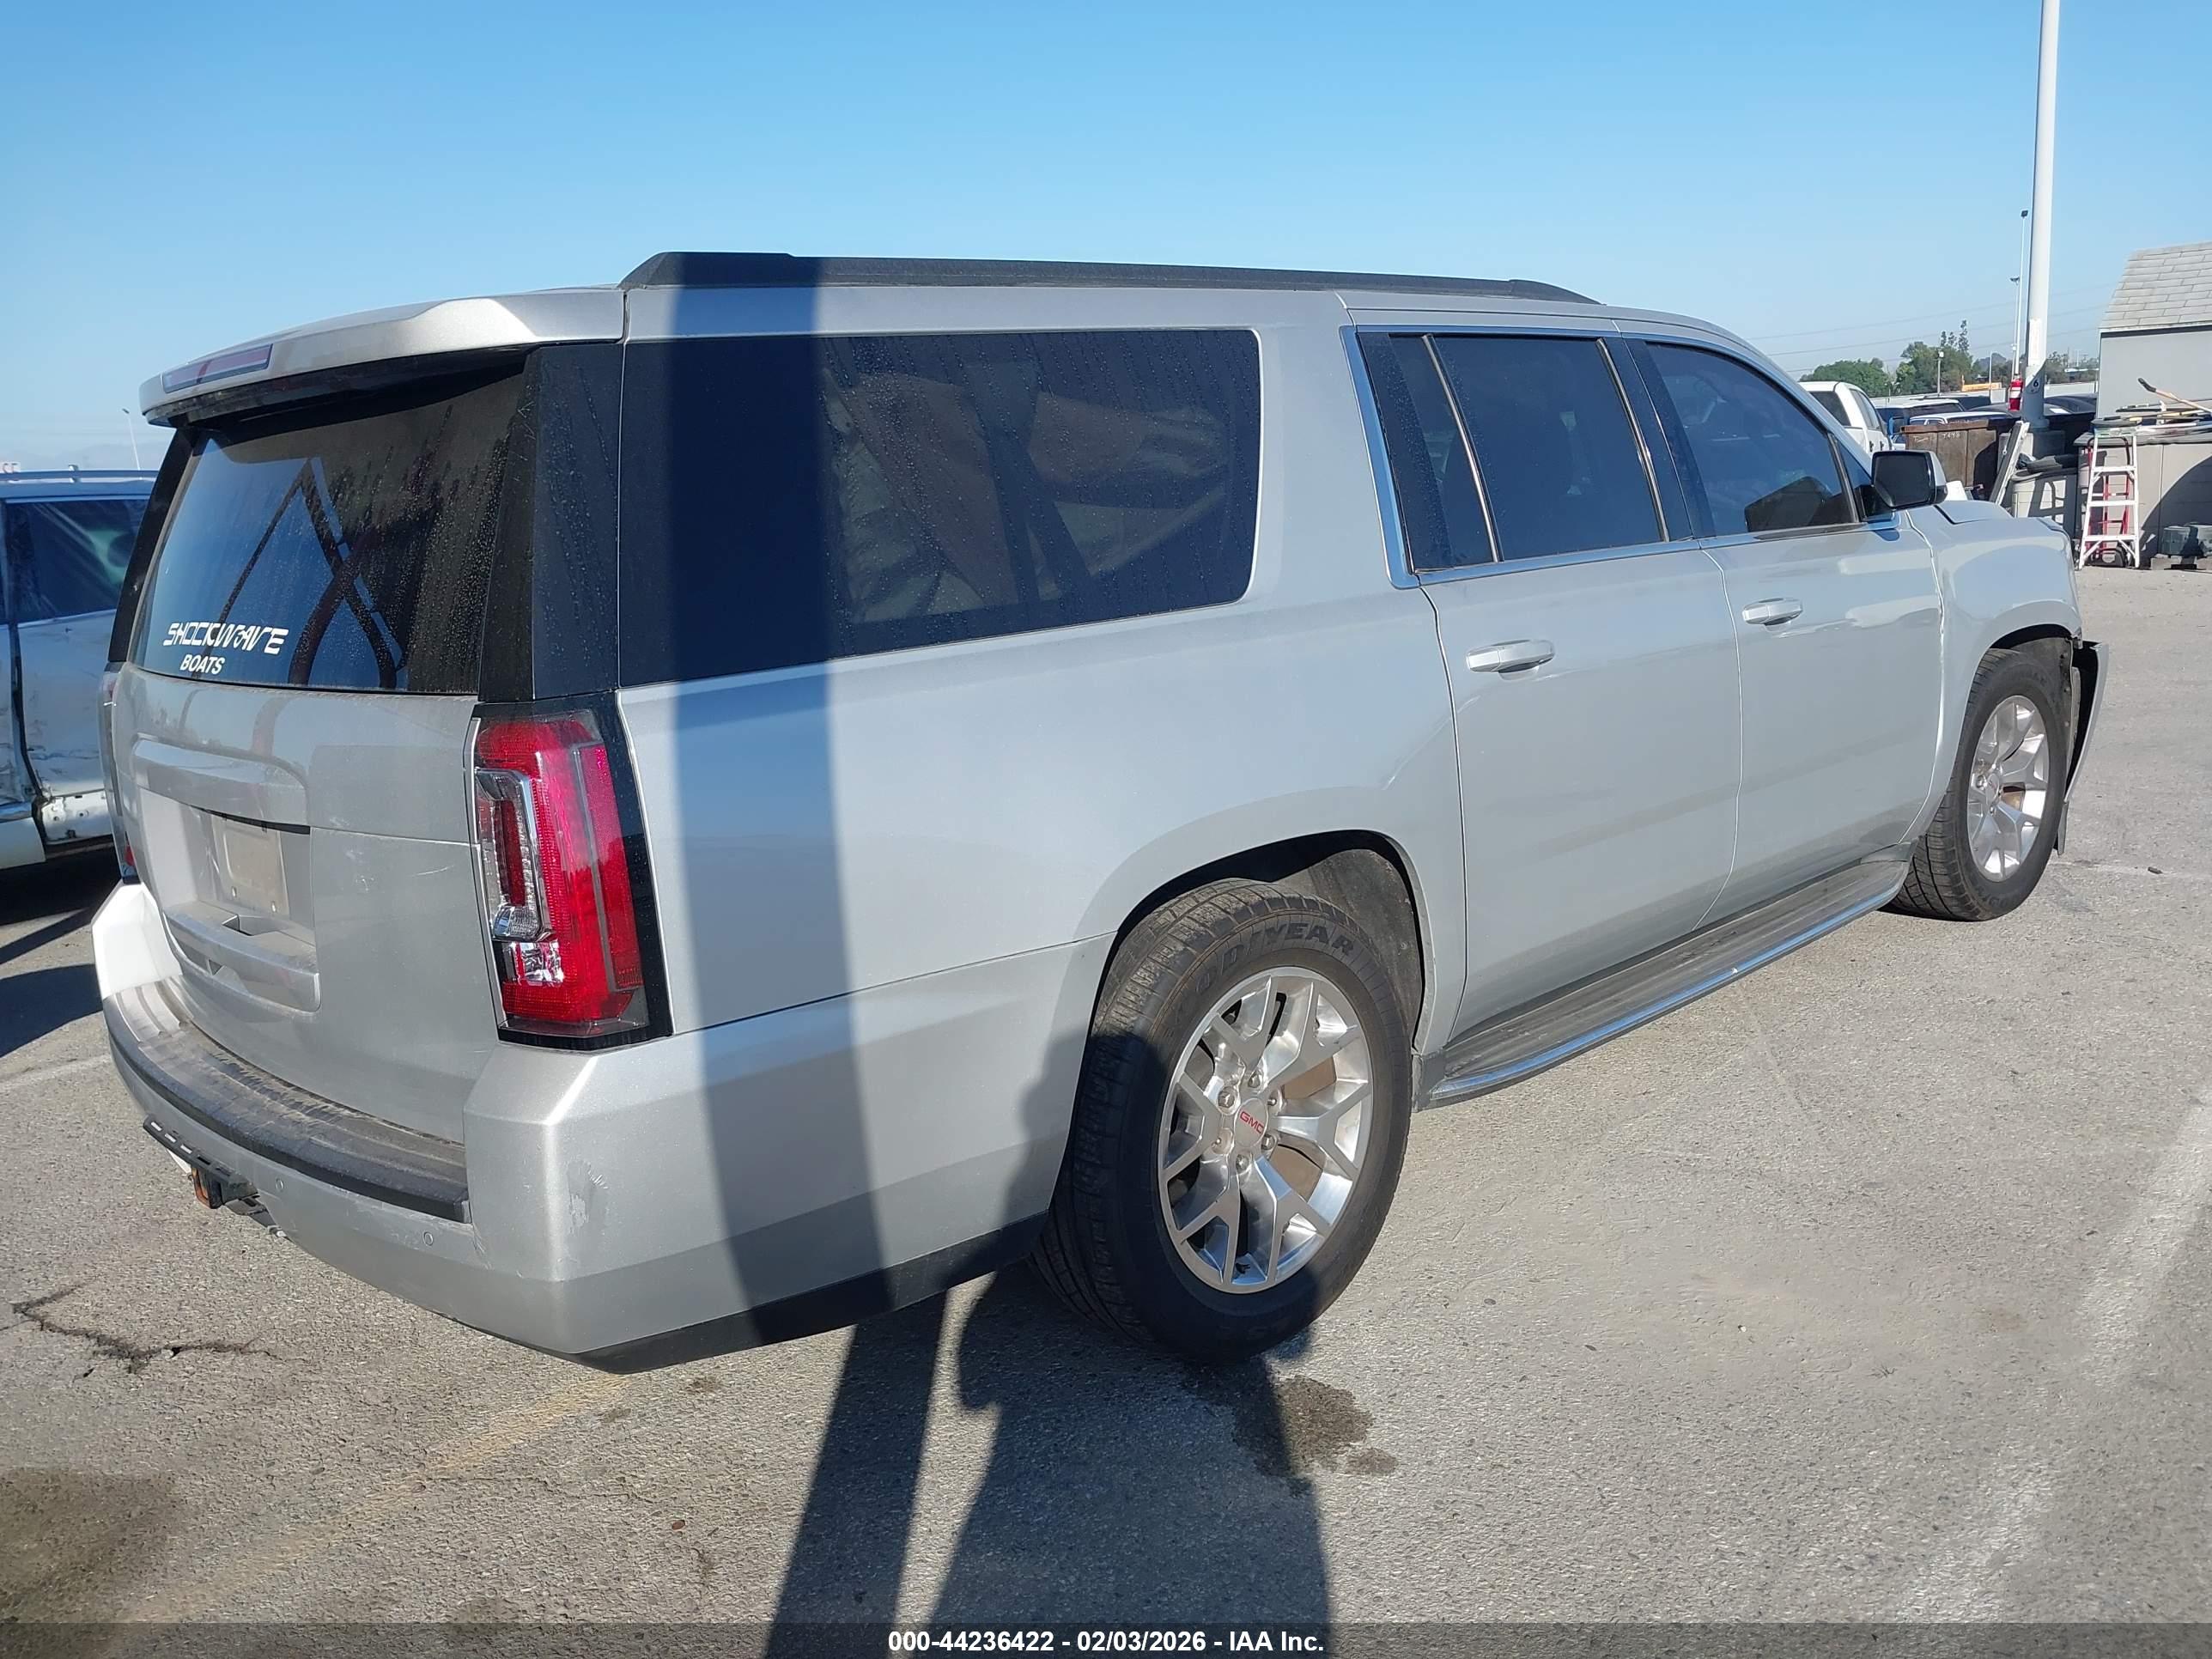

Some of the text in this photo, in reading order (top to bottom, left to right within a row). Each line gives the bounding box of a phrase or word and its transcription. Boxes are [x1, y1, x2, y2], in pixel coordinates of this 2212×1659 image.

[162, 622, 289, 655] SHOCKWAVE
[179, 653, 226, 675] BOATS
[1239, 1110, 1265, 1134] GMC
